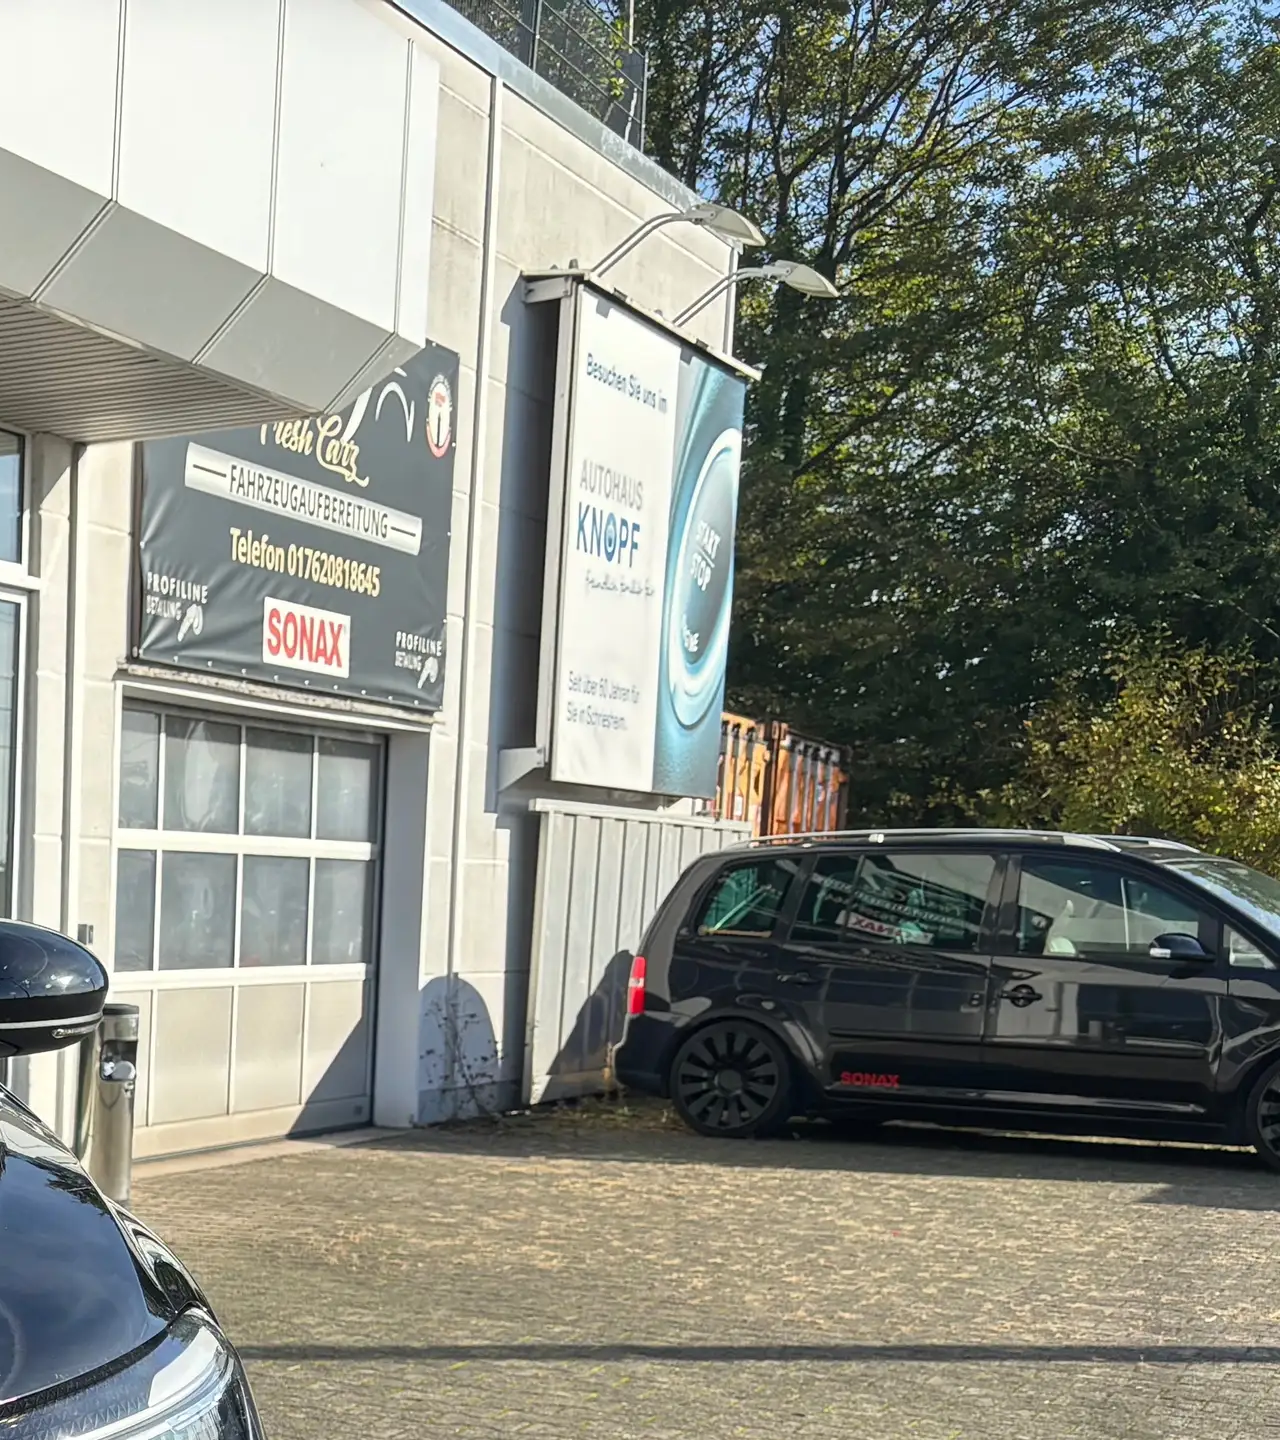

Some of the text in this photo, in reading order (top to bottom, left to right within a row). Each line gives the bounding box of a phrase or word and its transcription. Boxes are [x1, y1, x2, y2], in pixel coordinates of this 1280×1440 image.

[587, 353, 626, 394] Besuchen
[629, 374, 641, 400] Sie
[229, 464, 388, 539] FAHRZEUGAUFBEREITUNG
[580, 459, 643, 511] AUTOHAUS
[577, 501, 640, 568] KNOPF
[147, 571, 208, 604] PROFILINE
[230, 527, 380, 597] Telefon 017620818645
[268, 608, 342, 668] SONAX
[396, 631, 442, 656] PROFILINE
[841, 1071, 899, 1089] SONAX
